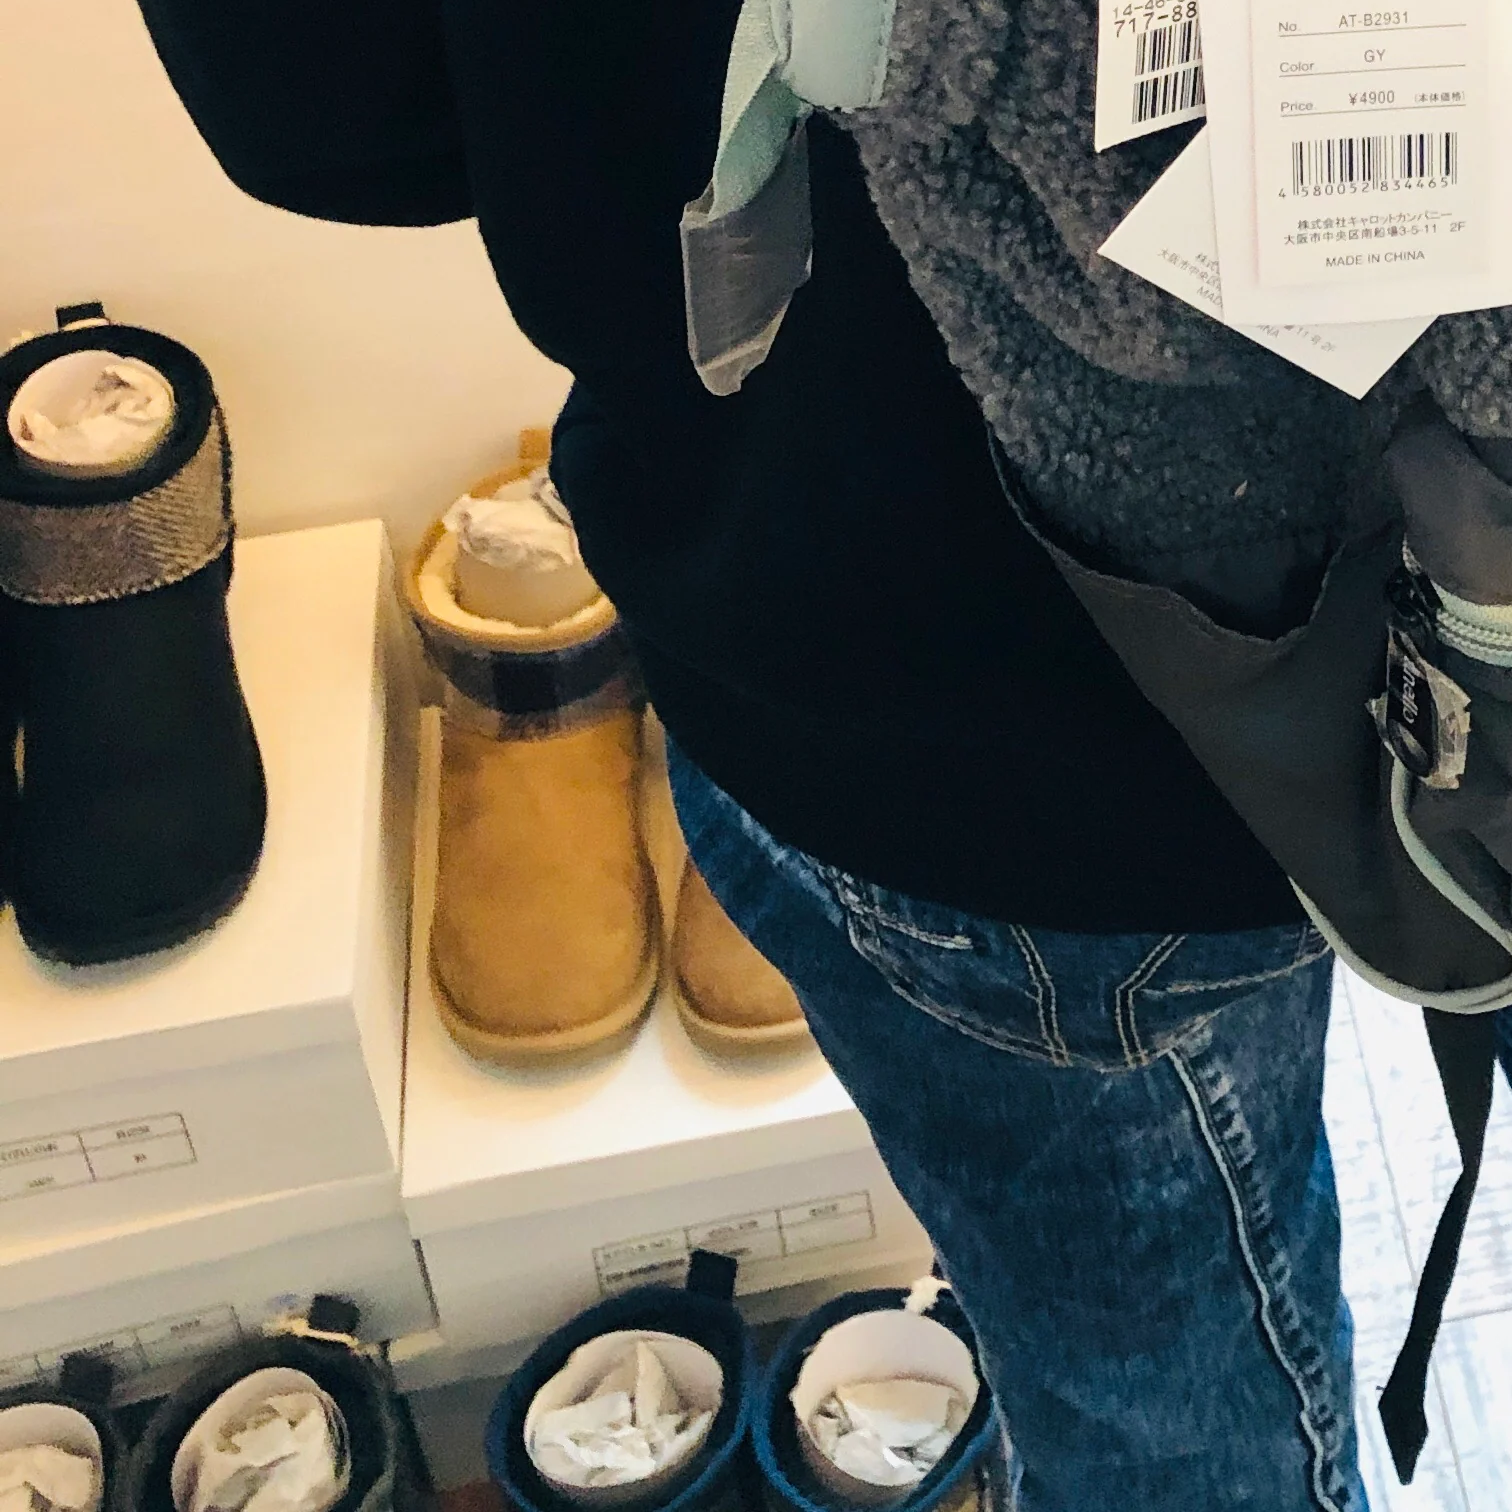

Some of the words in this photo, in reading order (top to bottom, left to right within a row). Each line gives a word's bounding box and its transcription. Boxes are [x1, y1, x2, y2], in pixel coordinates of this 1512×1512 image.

[1338, 11, 1409, 29] AT-B2931
[1364, 49, 1386, 63] GY
[1348, 90, 1395, 106] ¥4900
[1325, 254, 1363, 268] MADE
[1367, 253, 1381, 265] IN
[1384, 250, 1426, 264] CHINA
